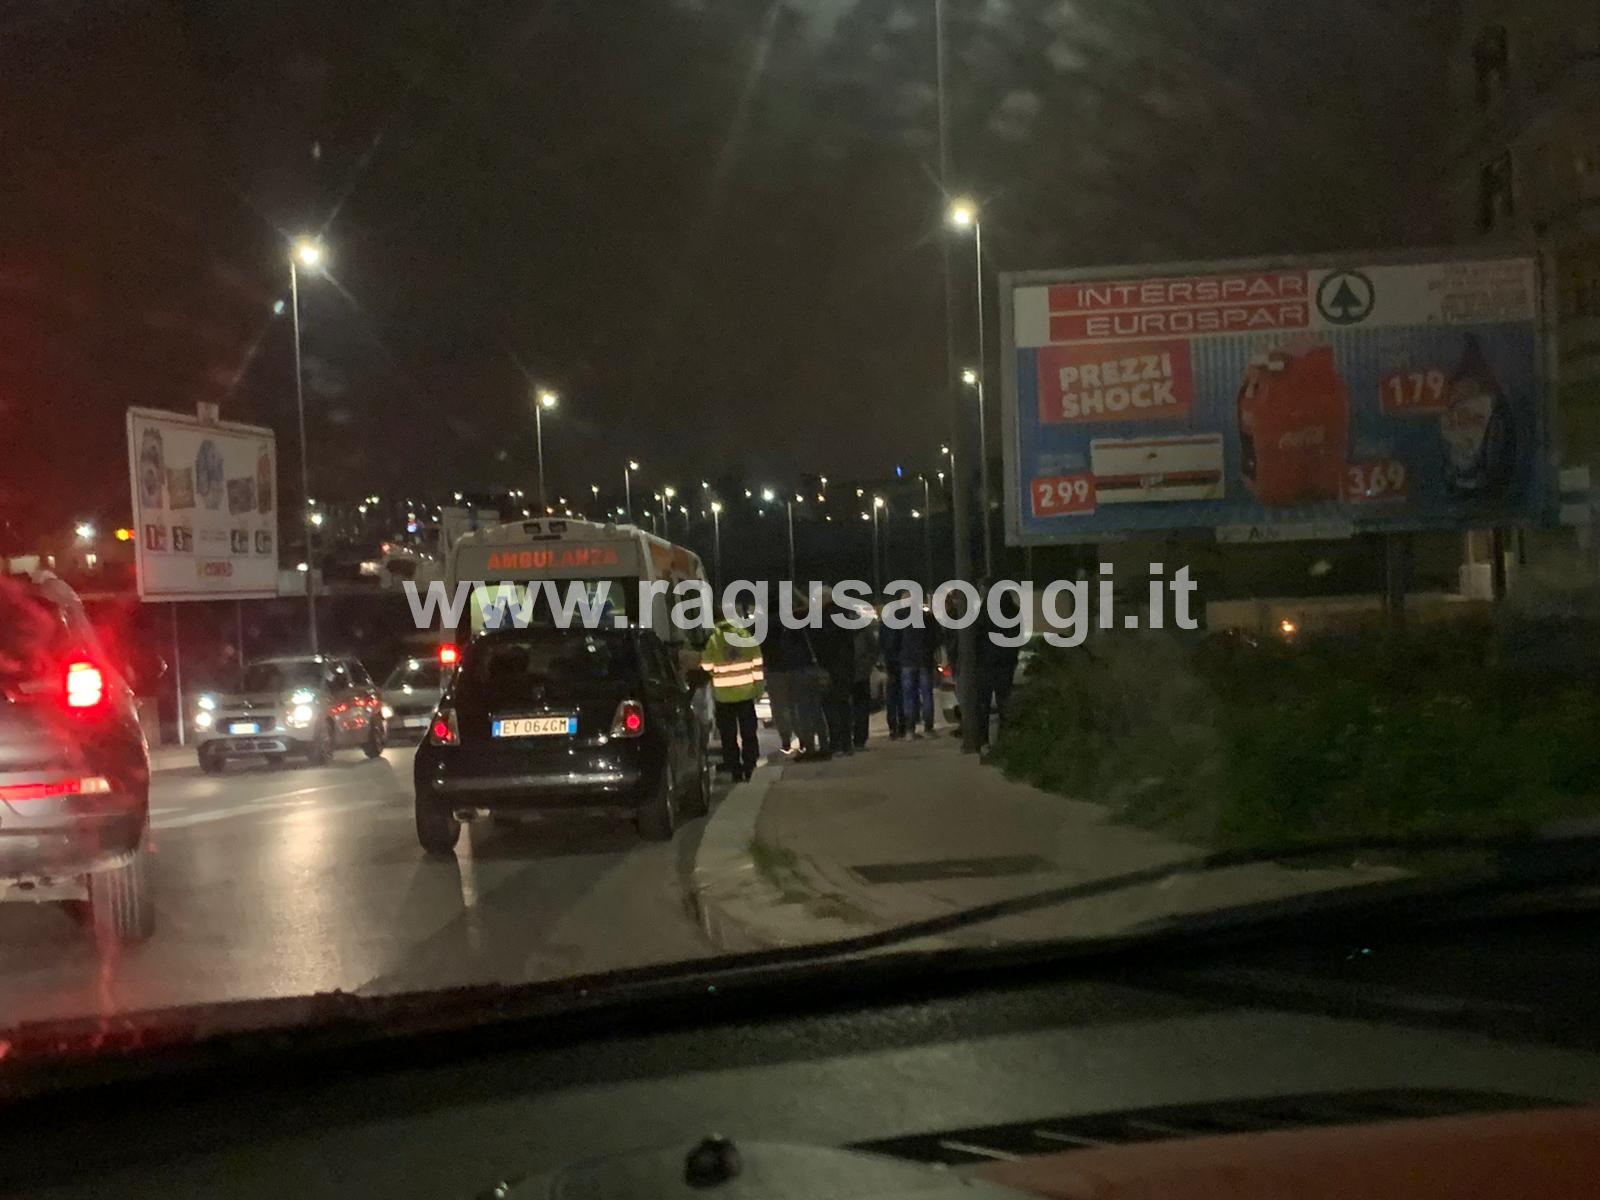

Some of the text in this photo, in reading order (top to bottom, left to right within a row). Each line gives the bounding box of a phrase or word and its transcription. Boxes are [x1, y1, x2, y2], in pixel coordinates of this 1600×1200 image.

[1077, 276, 1303, 307] INTERSPAR
[1086, 304, 1303, 336] EUROSPAR
[1059, 352, 1172, 391] PREZZI
[1061, 379, 1177, 418] SHOCK
[487, 547, 618, 570] AMBULANZA
[503, 721, 519, 734] EY
